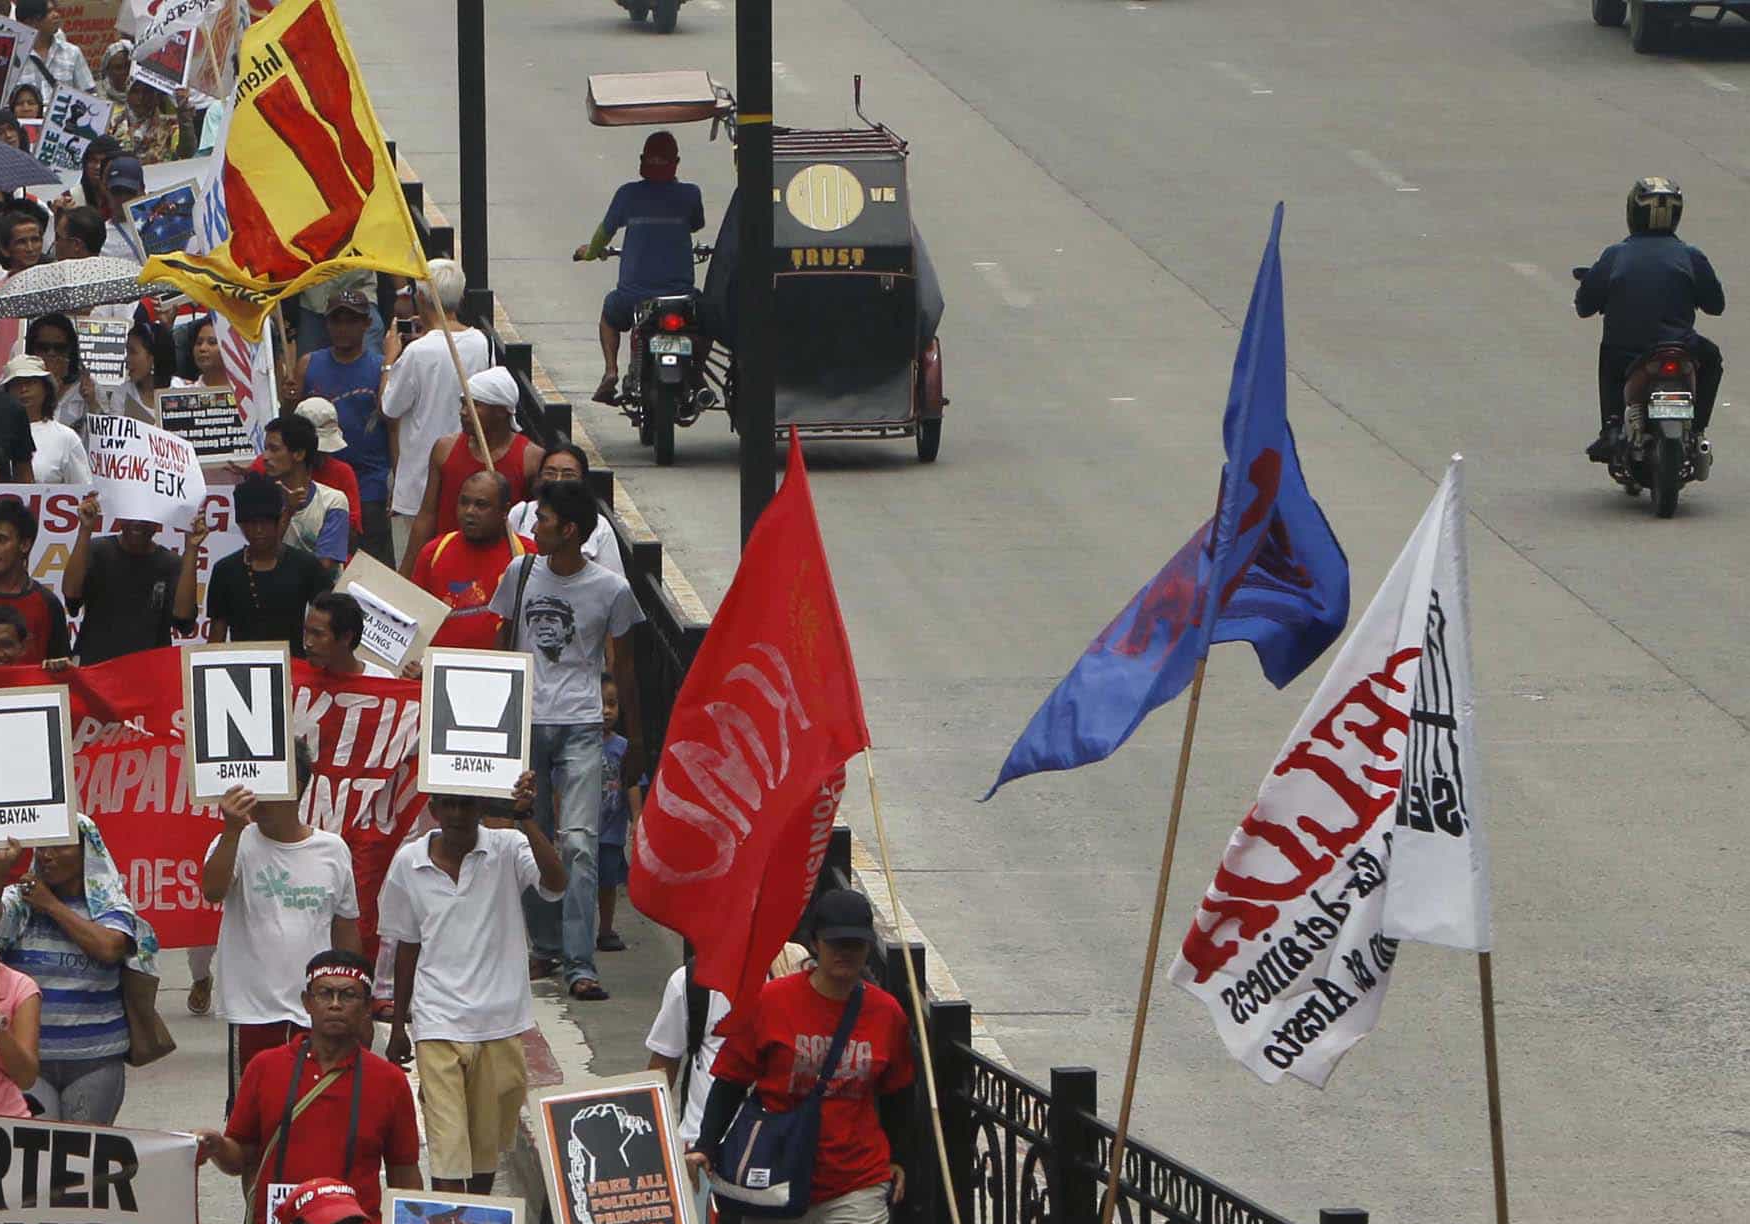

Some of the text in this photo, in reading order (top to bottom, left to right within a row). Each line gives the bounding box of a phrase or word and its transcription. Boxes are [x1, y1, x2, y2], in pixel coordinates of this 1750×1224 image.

[791, 248, 865, 266] TRUST
[100, 438, 126, 449] LAW
[90, 450, 150, 482] SALVAGING
[154, 470, 187, 499] EJK
[204, 667, 275, 758] N
[587, 1172, 667, 1195] FREE ALL
[590, 1190, 670, 1211] POLITICAL
